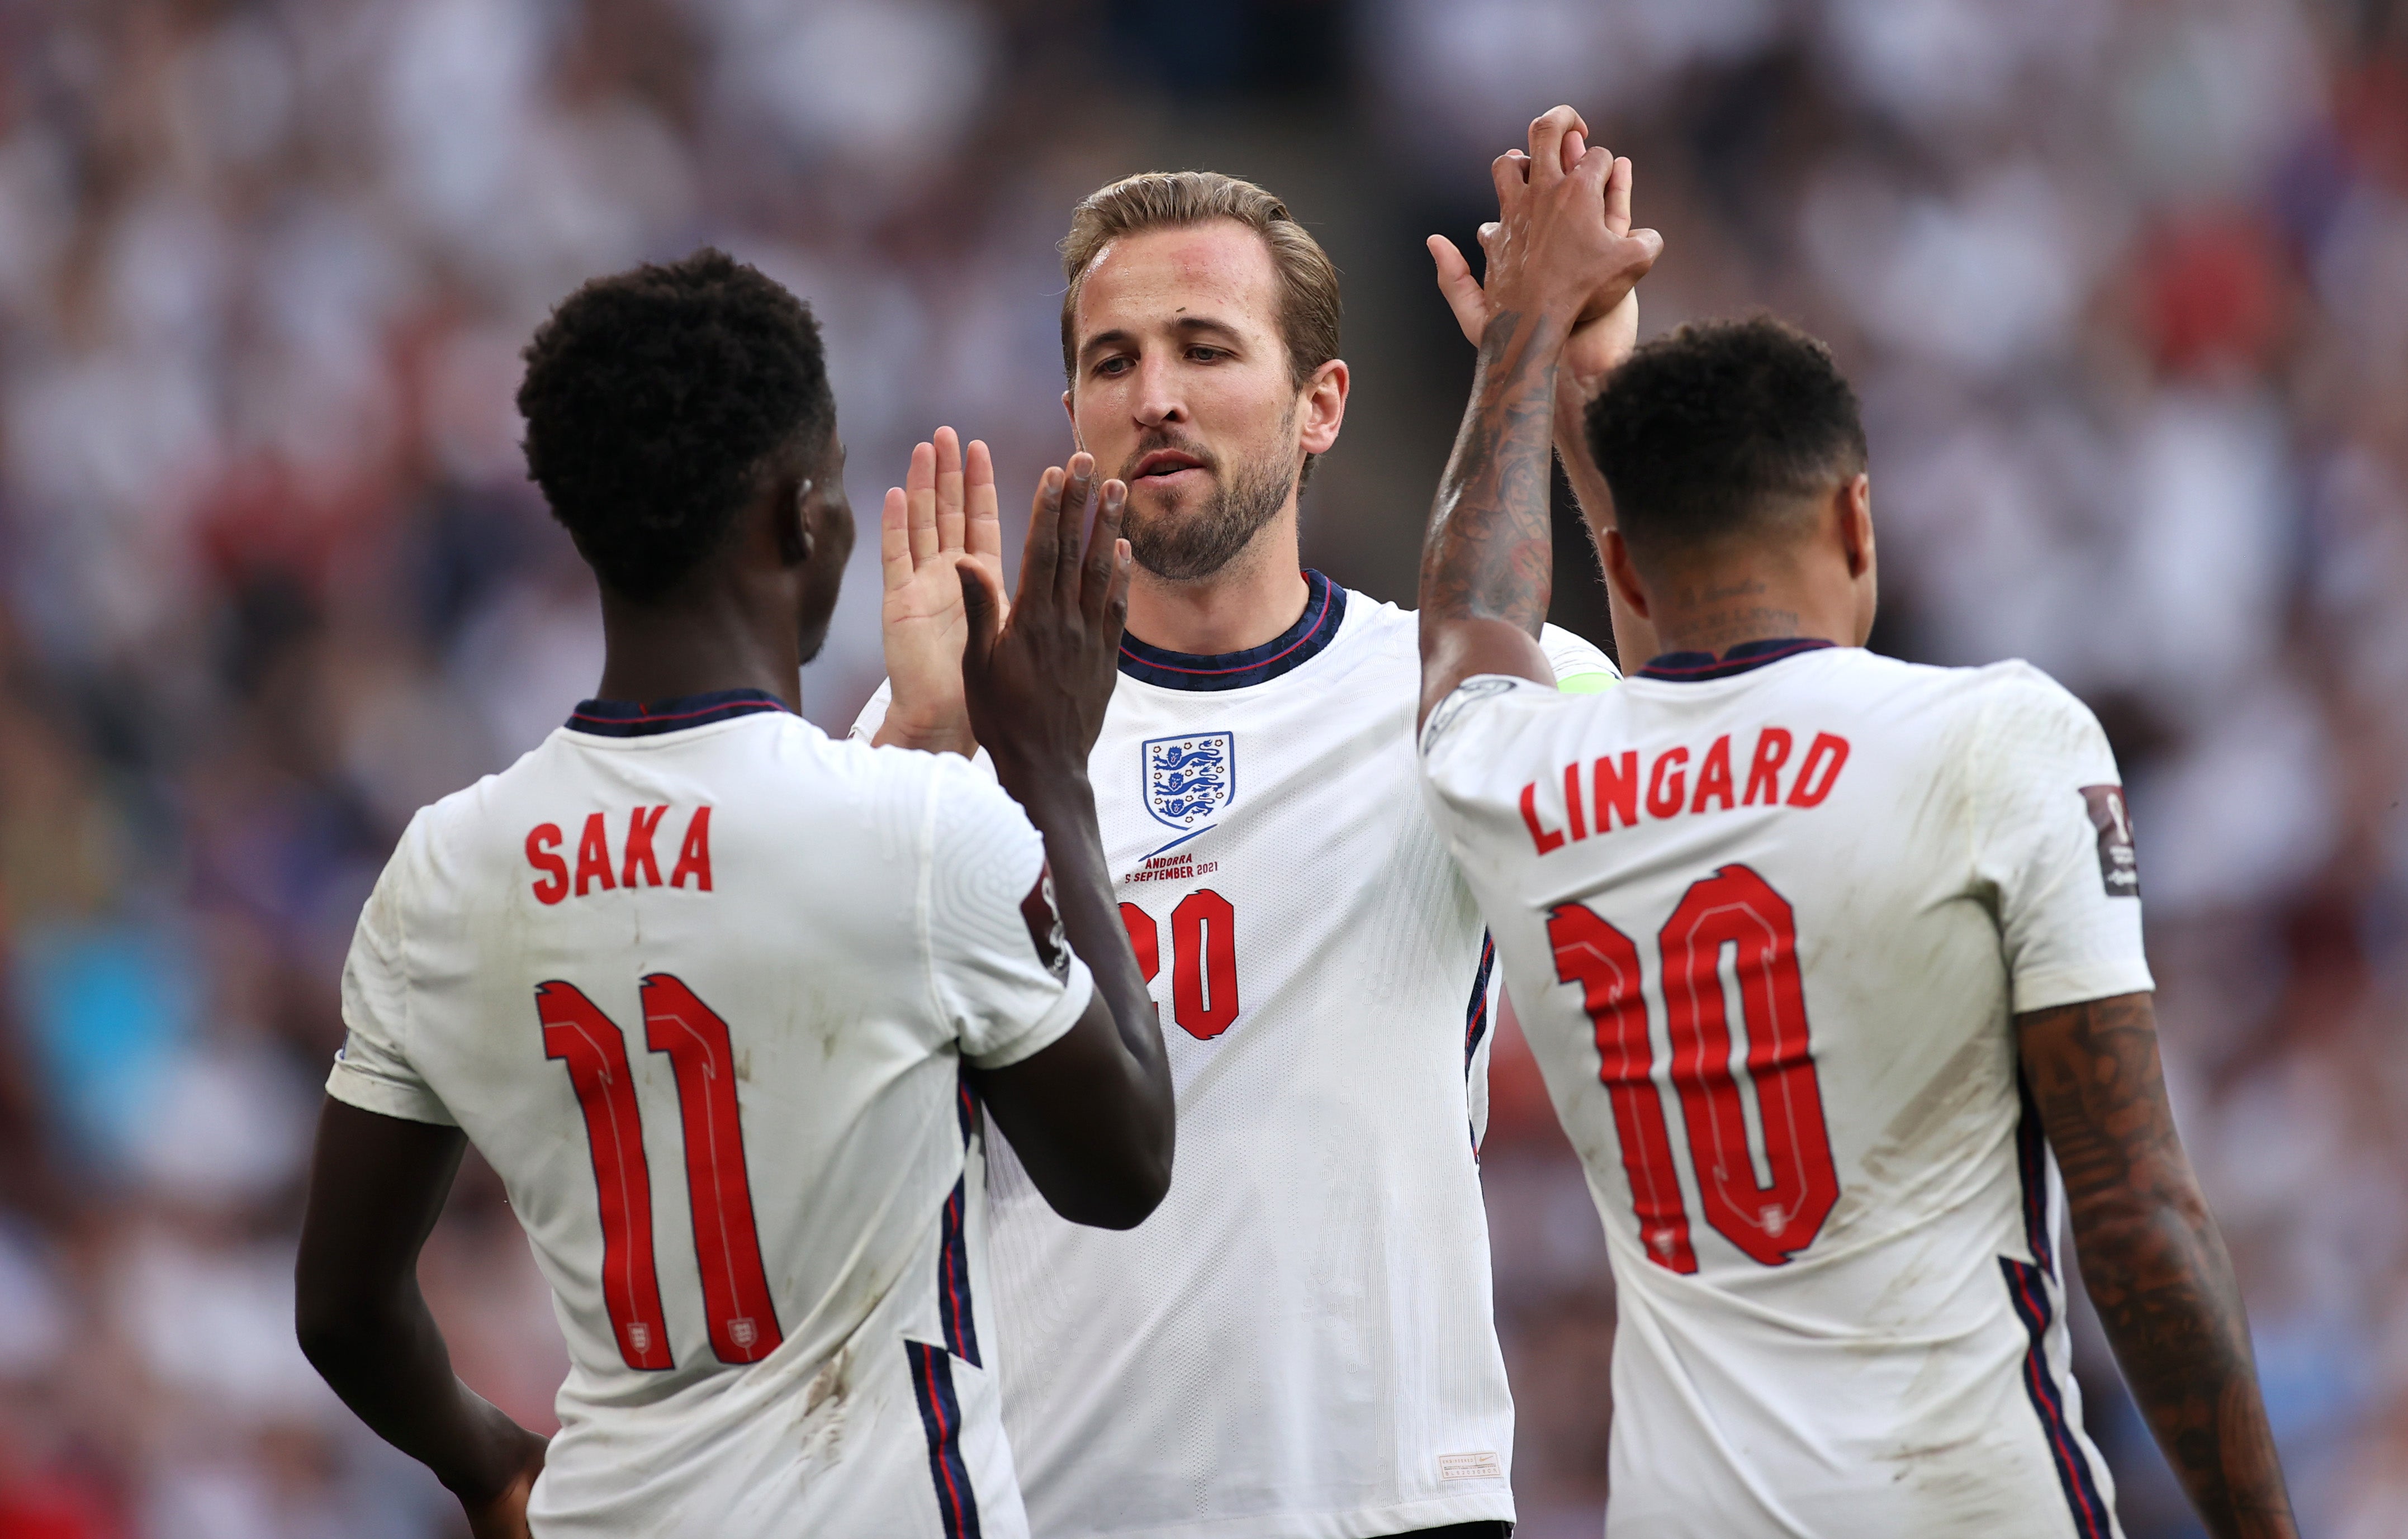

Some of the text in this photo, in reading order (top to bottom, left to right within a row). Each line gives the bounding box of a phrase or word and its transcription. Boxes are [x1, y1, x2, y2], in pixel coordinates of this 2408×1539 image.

[1519, 728, 1850, 856] LINGARD
[525, 805, 713, 905] SAKA
[1125, 861, 1218, 884] 5 SEPTEMBER 2021
[1145, 853, 1193, 870] ANDORRA
[1546, 863, 1841, 1276] 10
[535, 972, 783, 1370] 11
